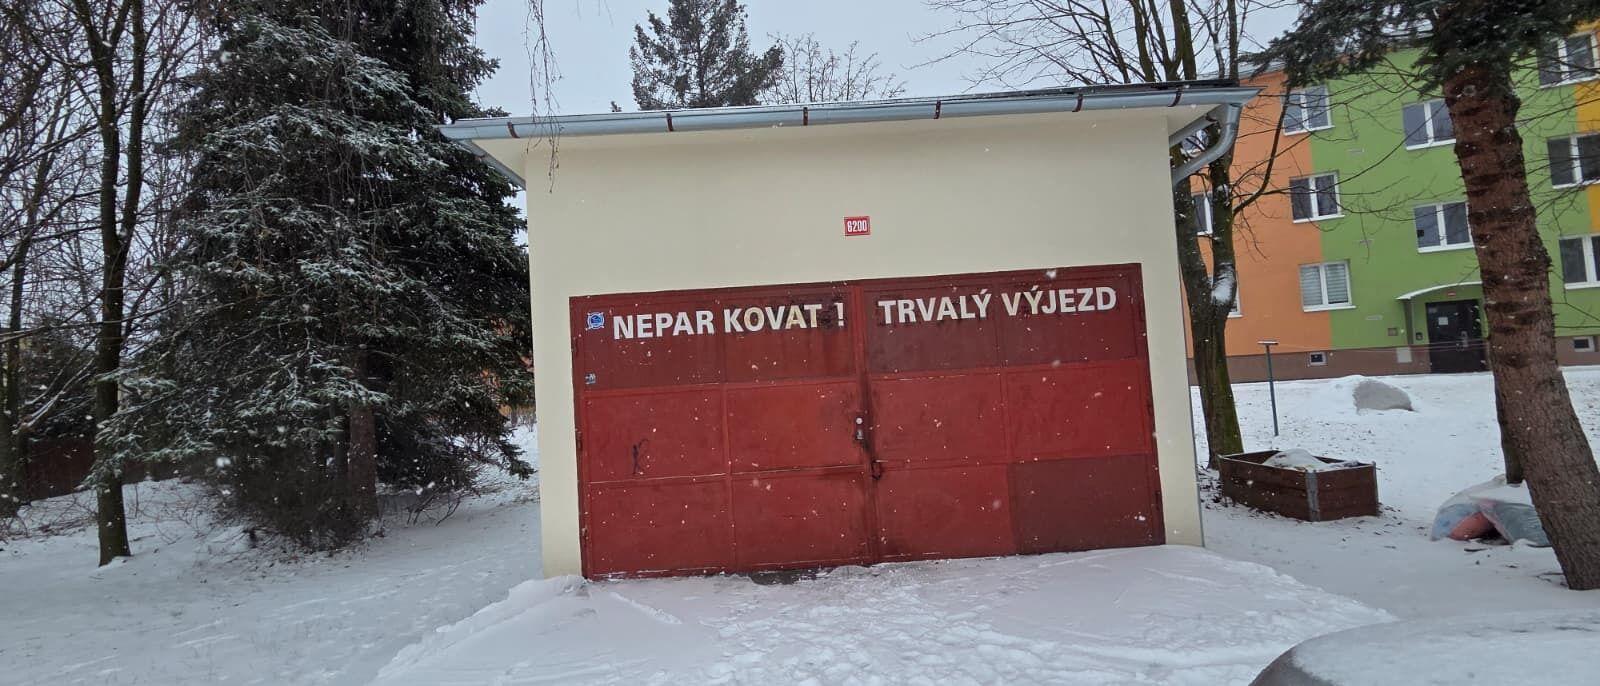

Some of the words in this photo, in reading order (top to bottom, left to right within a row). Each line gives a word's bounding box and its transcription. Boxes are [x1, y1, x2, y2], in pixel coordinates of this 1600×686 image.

[847, 219, 868, 233] 6200
[878, 289, 992, 324] TRVALÝ
[1001, 284, 1117, 316] VÝJEZD
